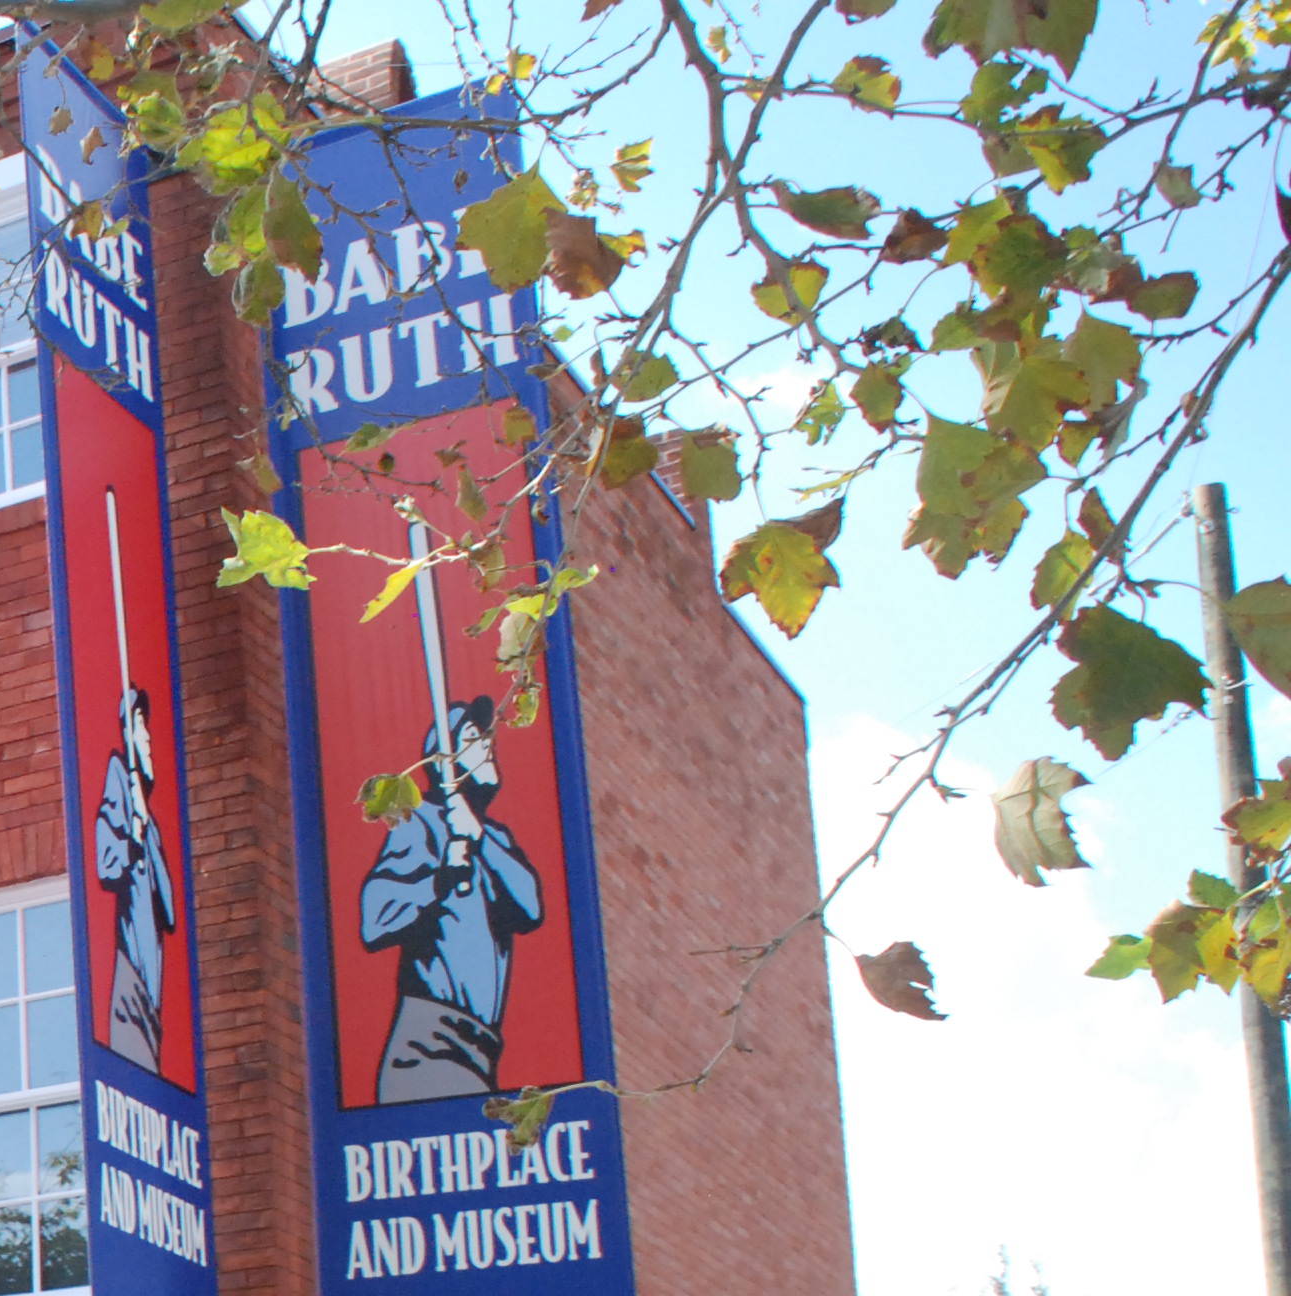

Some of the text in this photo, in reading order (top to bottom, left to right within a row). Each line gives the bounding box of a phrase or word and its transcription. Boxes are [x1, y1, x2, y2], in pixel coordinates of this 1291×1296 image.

[42, 240, 154, 403] RUTH
[276, 293, 520, 421] RUTH
[95, 1079, 203, 1190] BIRTHPLACE
[343, 1120, 597, 1203] BIRTHPLACE
[101, 1162, 207, 1268] AND MUSEUM
[346, 1199, 604, 1280] AND MUSEUM
